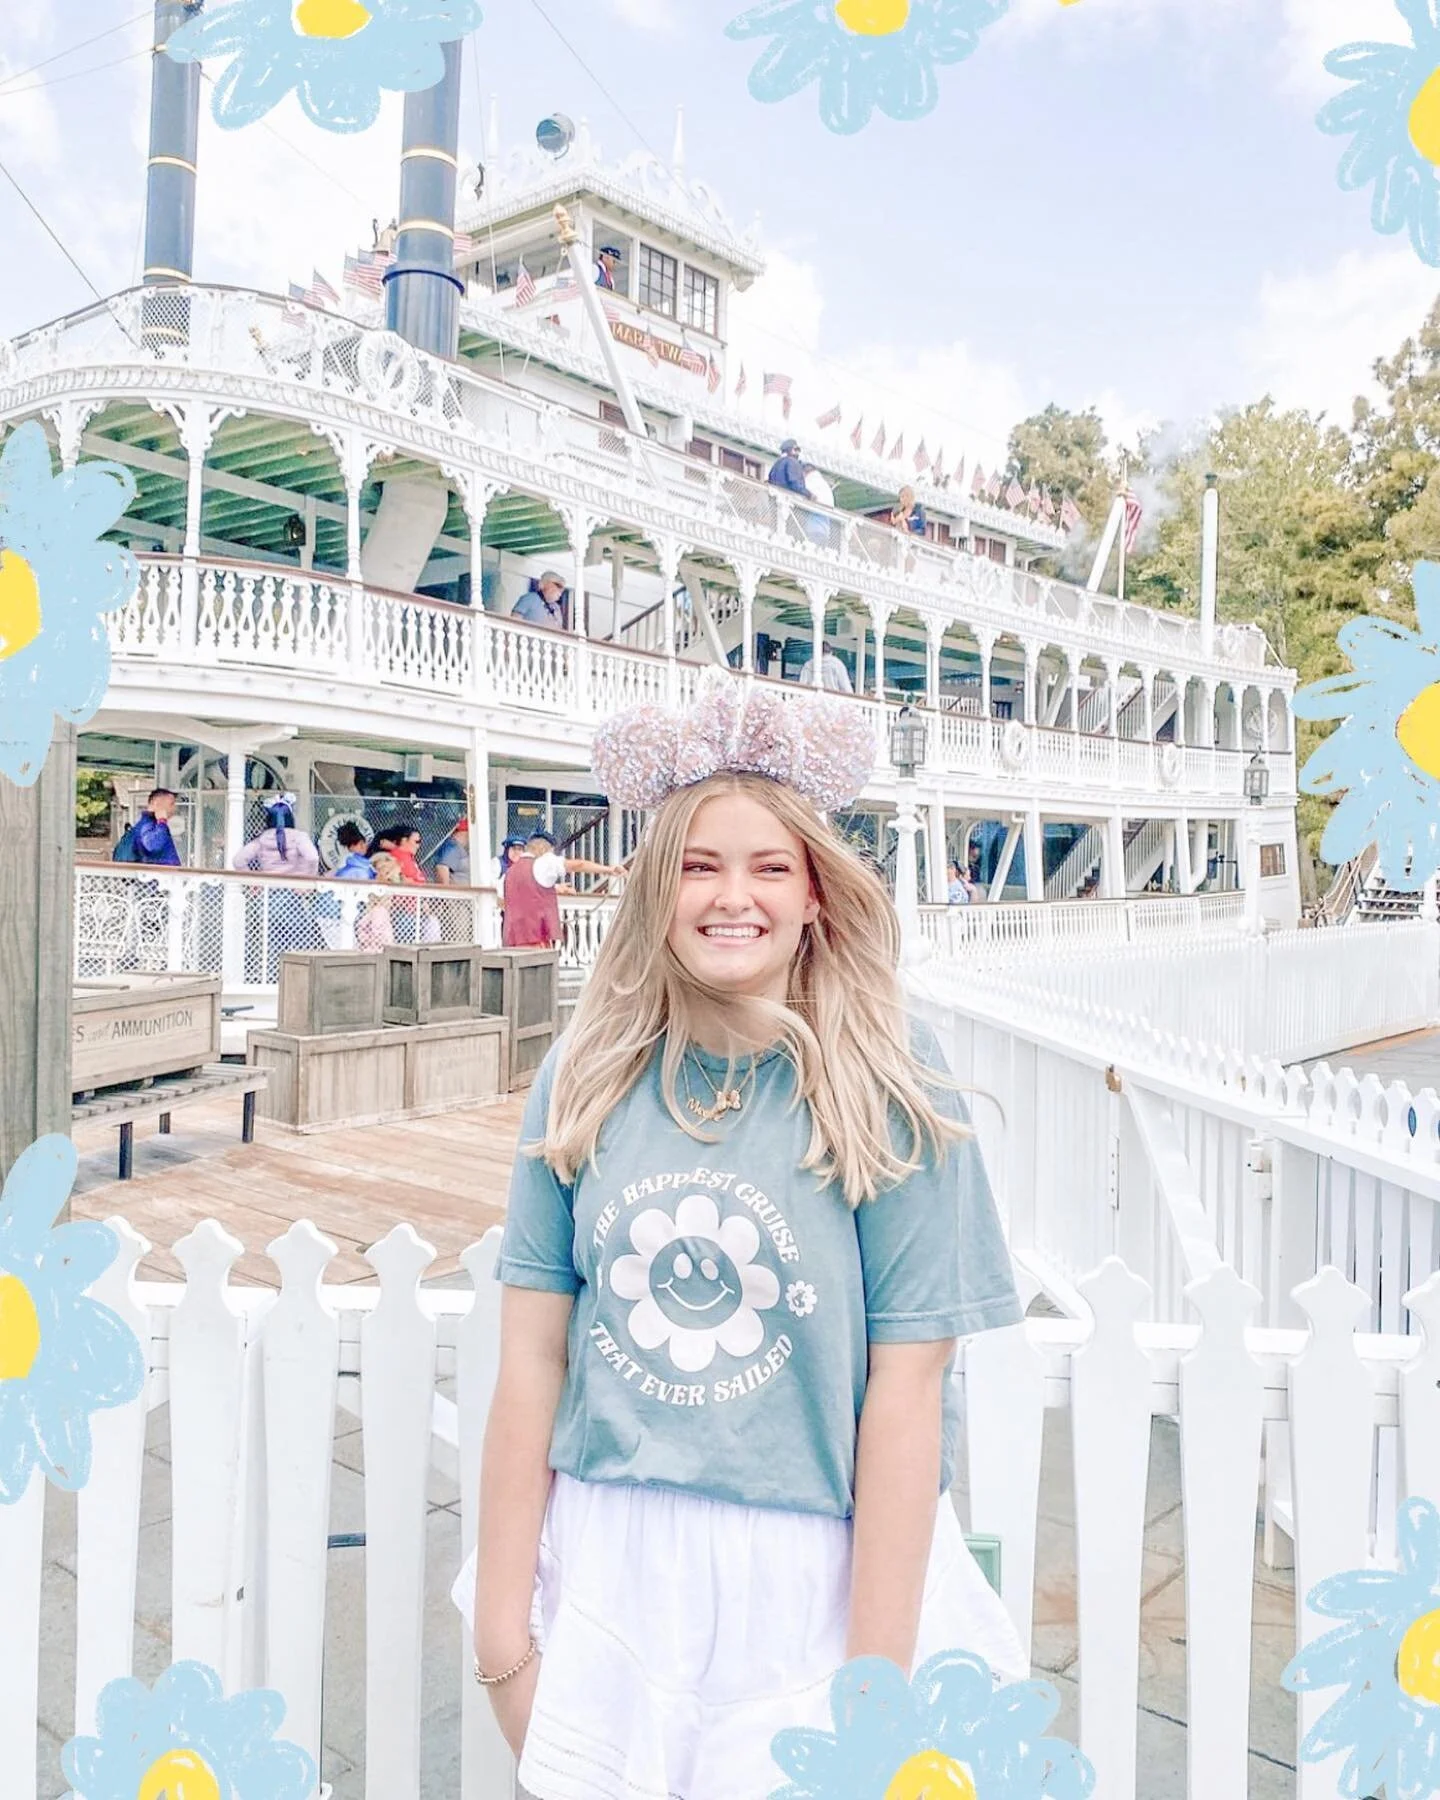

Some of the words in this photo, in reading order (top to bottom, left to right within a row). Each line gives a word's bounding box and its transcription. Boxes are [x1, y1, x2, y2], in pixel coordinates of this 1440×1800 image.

[111, 1009, 193, 1040] AMMUNITION
[593, 1200, 620, 1248] THE
[734, 1183, 800, 1264] CRUISE
[590, 1321, 644, 1381] THAT
[639, 1376, 706, 1407] EVER
[713, 1334, 793, 1403] SAILED
